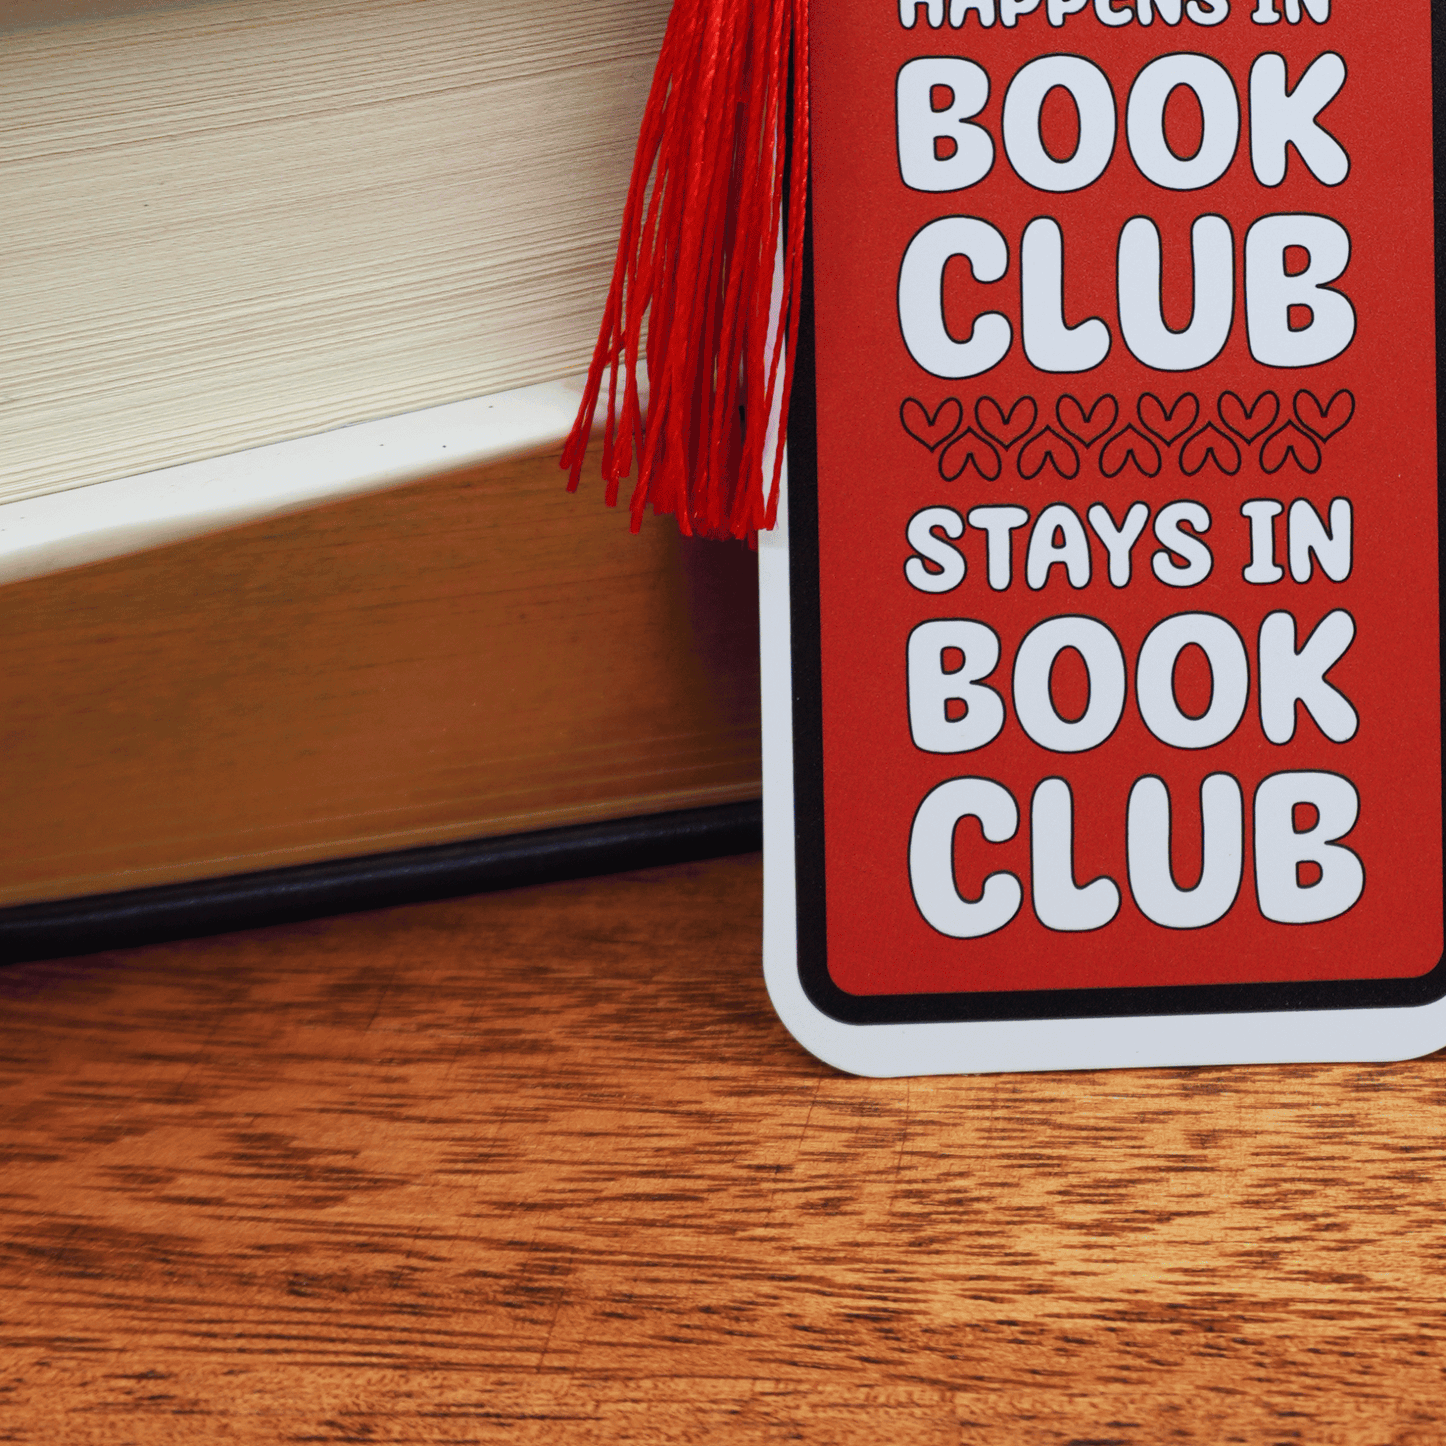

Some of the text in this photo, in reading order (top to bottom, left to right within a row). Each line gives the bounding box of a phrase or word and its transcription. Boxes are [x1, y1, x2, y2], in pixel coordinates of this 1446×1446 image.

[895, 52, 1351, 194] BOOK
[896, 212, 1357, 380] CLUB
[903, 497, 1353, 592] STAYS IN
[906, 608, 1360, 755] BOOK
[907, 770, 1366, 940] CLUB
